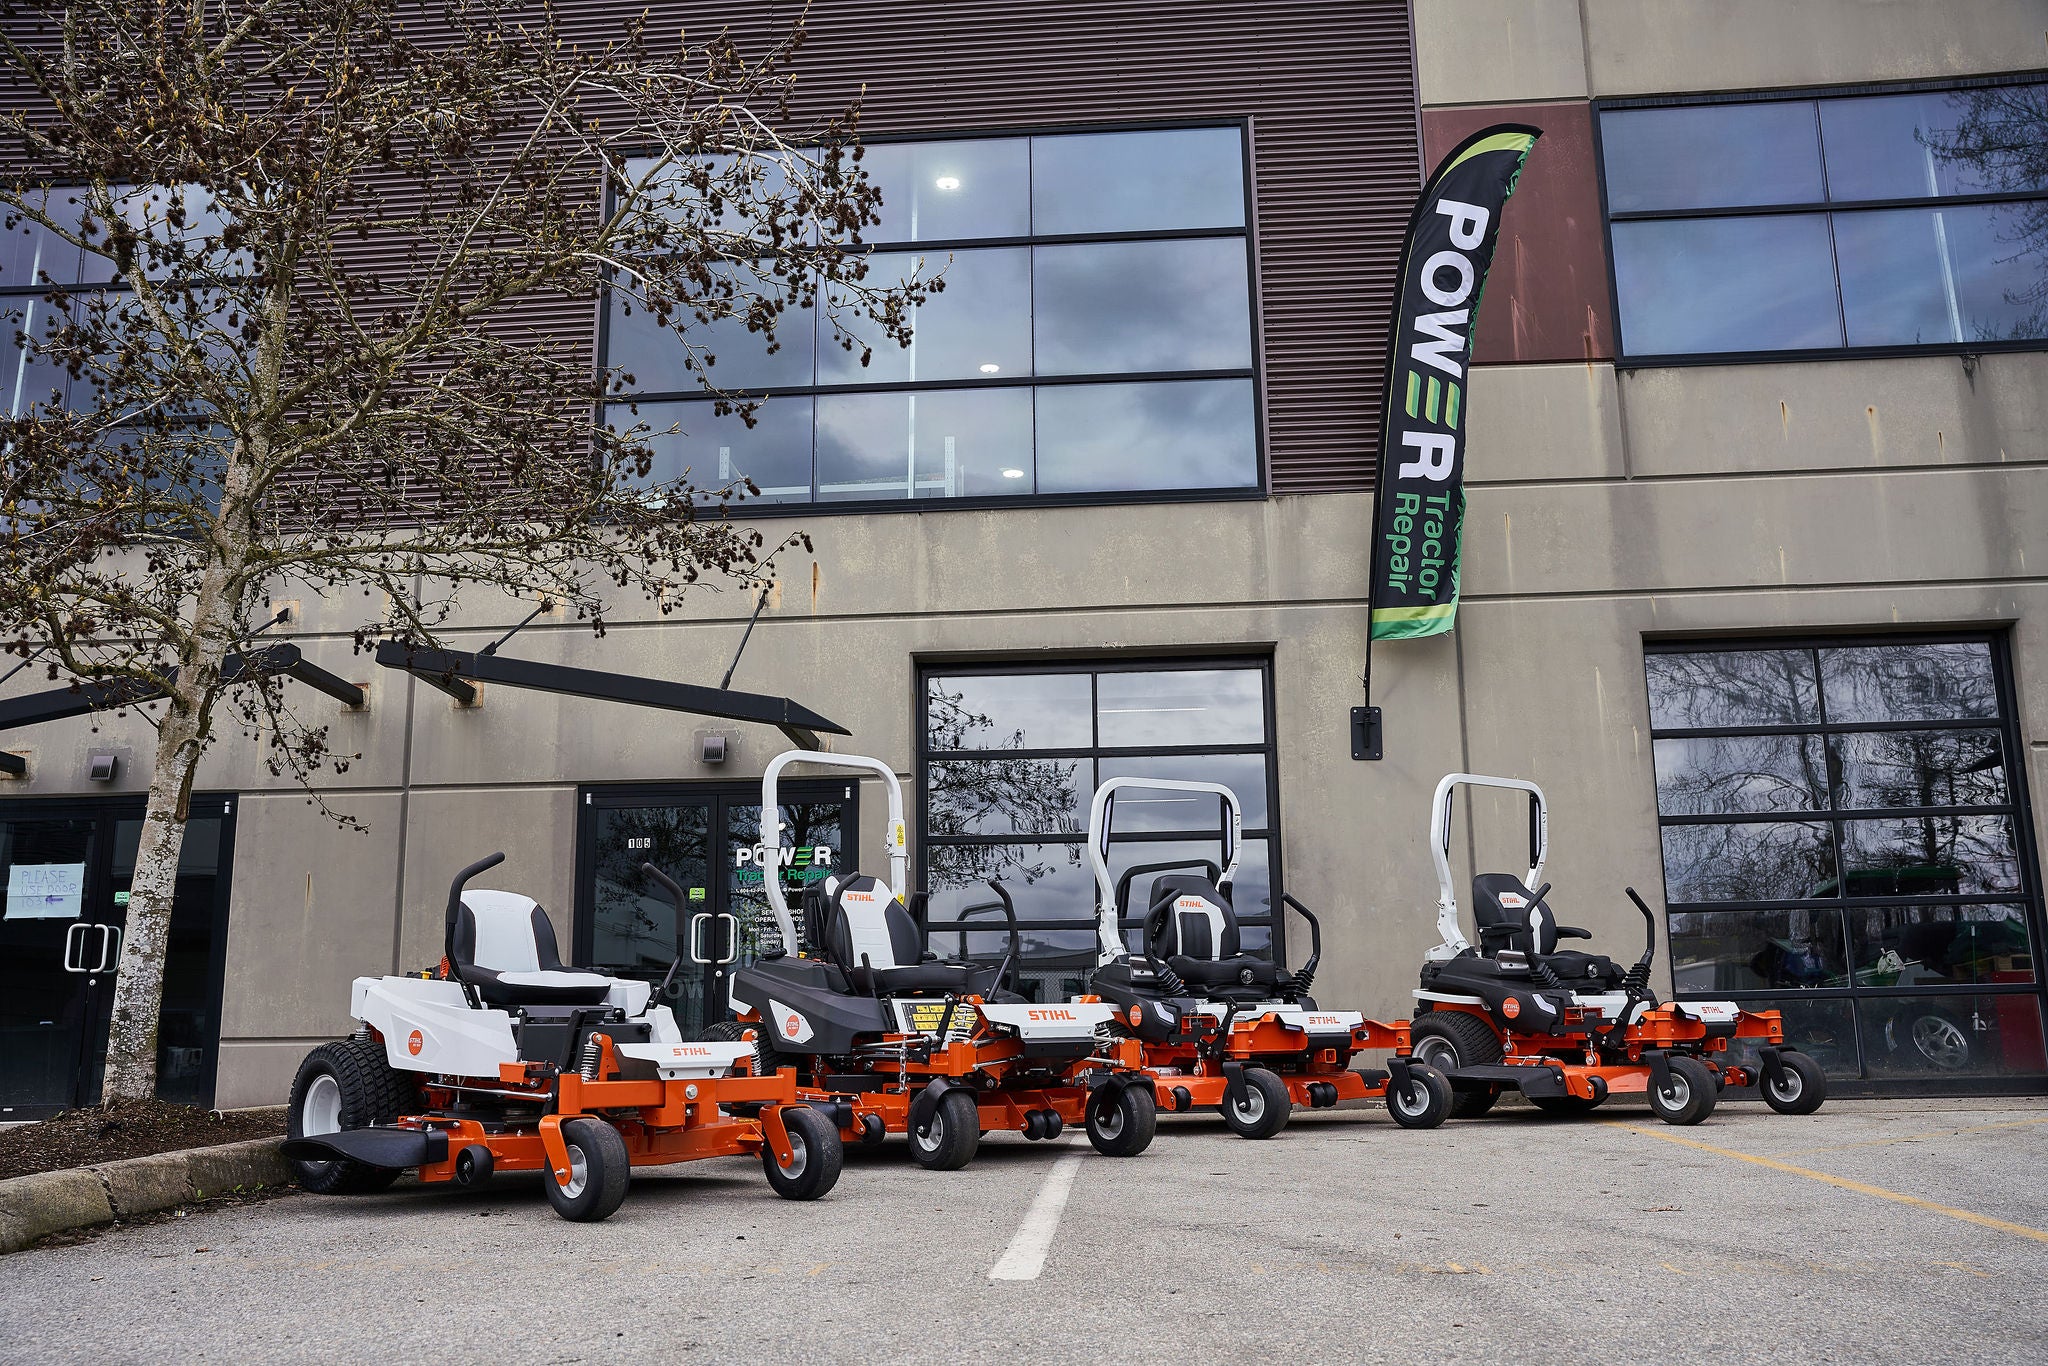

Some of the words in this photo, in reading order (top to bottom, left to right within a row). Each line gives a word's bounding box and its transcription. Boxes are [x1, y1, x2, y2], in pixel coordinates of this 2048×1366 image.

[1399, 199, 1490, 482] POWER
[1386, 492, 1422, 595] Repair
[1418, 490, 1451, 601] Tractor
[628, 838, 651, 849] 105
[21, 870, 68, 884] PLEASE
[787, 867, 832, 884] Repair
[47, 883, 77, 896] DOOR
[847, 893, 875, 902] STIHL
[1028, 1010, 1077, 1021] STIHL
[1701, 1006, 1724, 1014] STIHL
[1308, 1016, 1341, 1025] STIHL
[672, 1047, 712, 1057] STIHL
